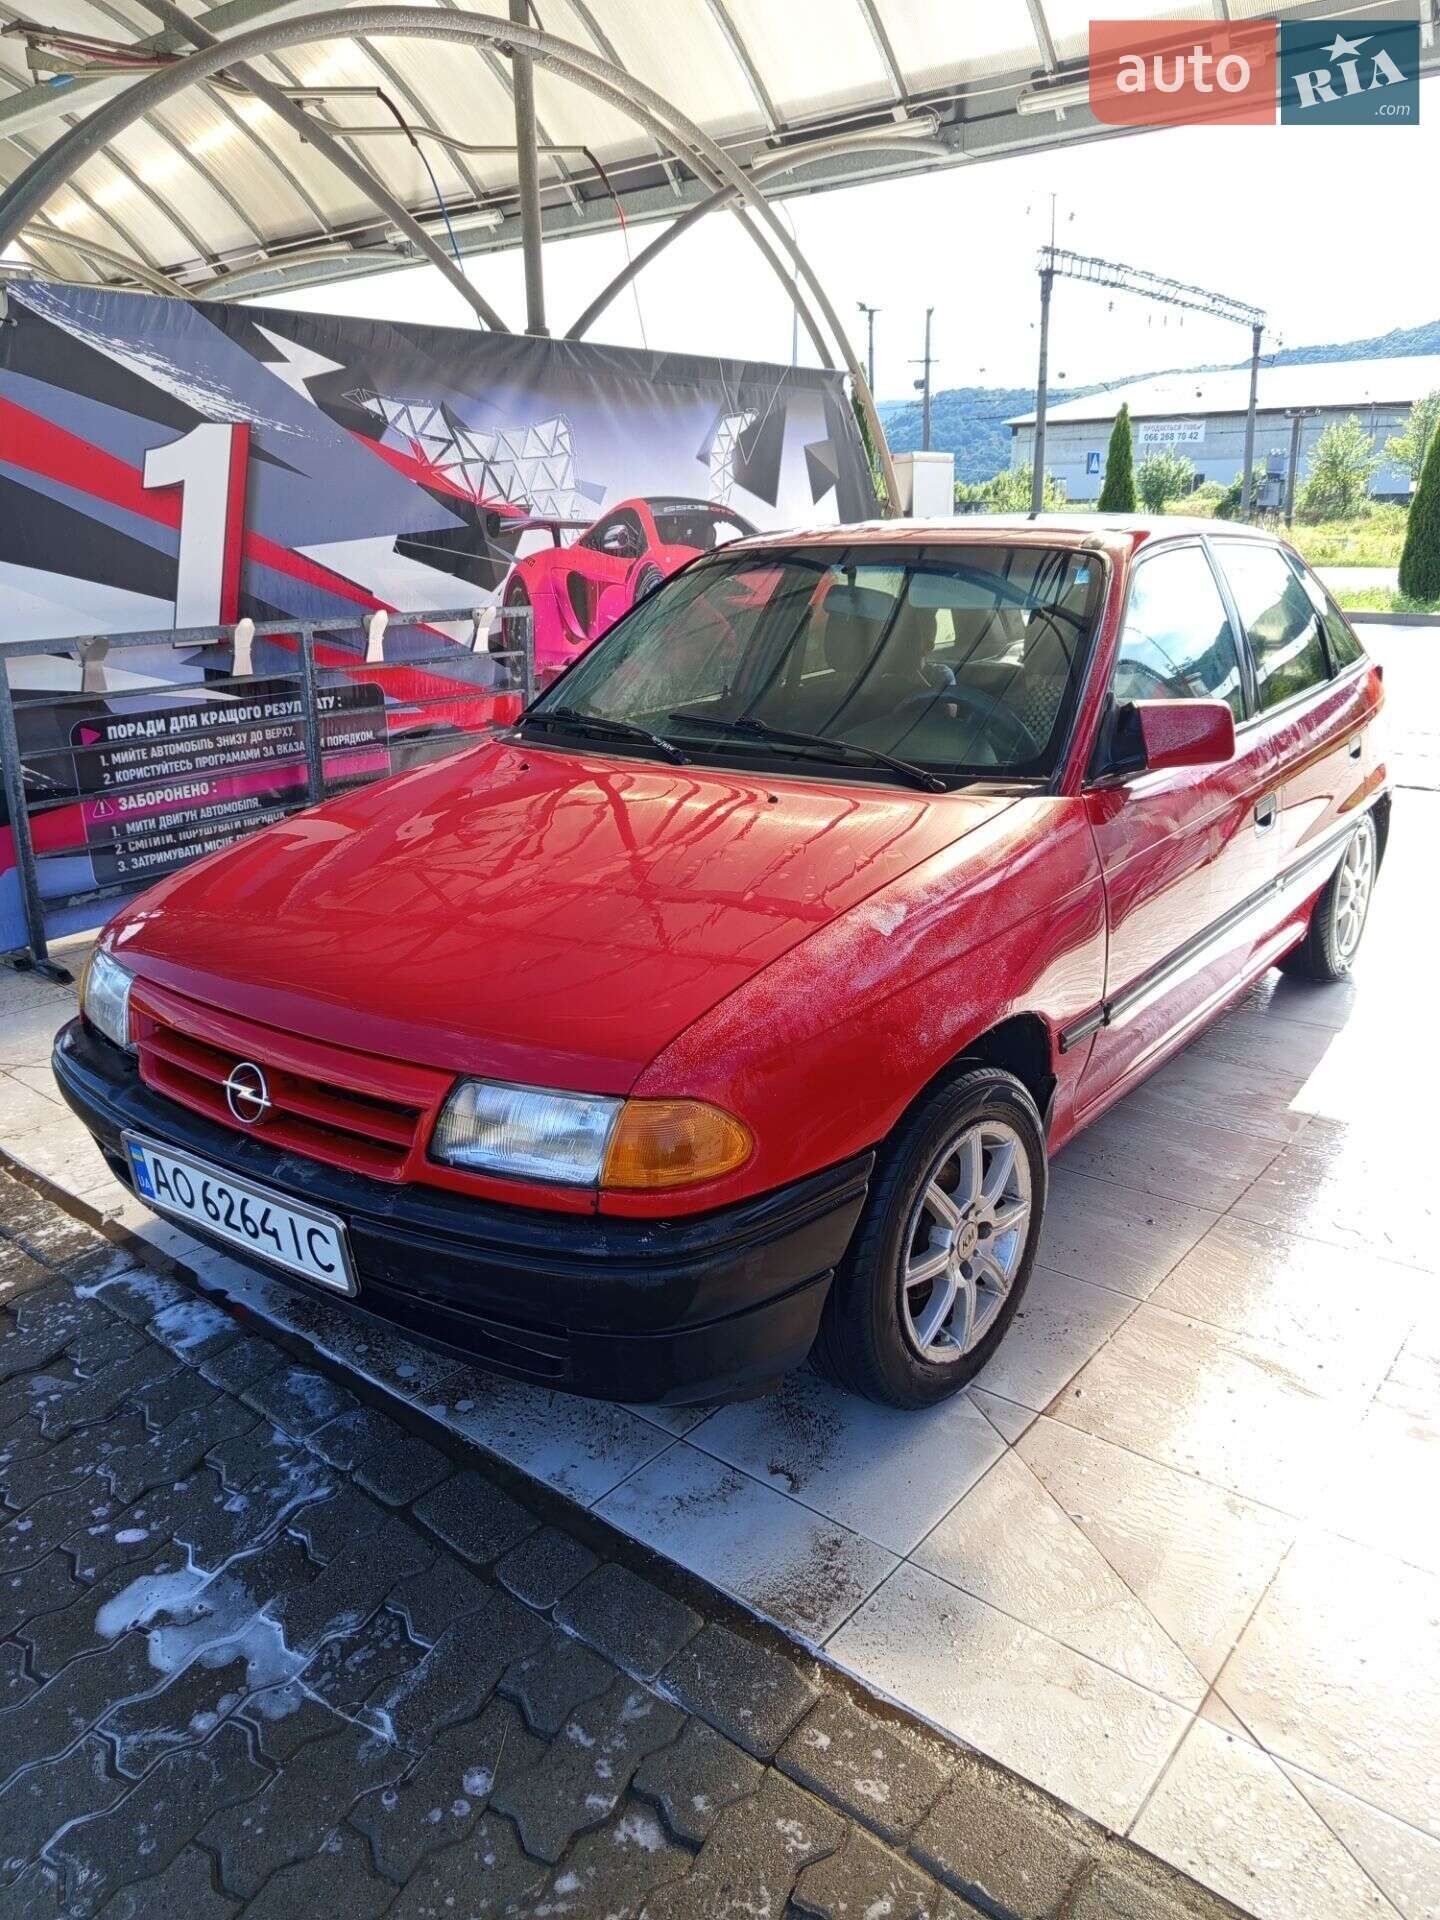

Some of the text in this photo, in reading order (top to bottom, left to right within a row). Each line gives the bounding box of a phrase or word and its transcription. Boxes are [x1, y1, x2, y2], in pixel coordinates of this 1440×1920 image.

[142, 422, 247, 648] 1
[107, 718, 166, 740] ПОРАДИ
[169, 714, 198, 734] ДЛЯ
[200, 706, 261, 726] КРАЩОГО
[103, 773, 114, 785] 2.
[115, 760, 193, 783] КОРИСТУЙТЕСЬ
[195, 747, 261, 769] ПРОГРАМАМИ
[263, 746, 275, 758] ЗА
[326, 731, 376, 747] ПОРЯДКОМ.
[111, 748, 148, 765] МИЙТЕ
[150, 738, 214, 759] АВТОМОБІЛЬ
[216, 734, 247, 748] ЗНИЗУ
[250, 730, 263, 744] ДО
[265, 725, 296, 740] ВЕРХУ.
[118, 782, 209, 811] ЗАБОРОНЕНО
[111, 797, 262, 837] 1. МИТИ ДВИГУН АВТОМОБІЛЯ.
[115, 843, 126, 855] 2.
[117, 860, 129, 872] 3.
[131, 845, 202, 869] ЗАТРИМУВАТИ
[152, 1157, 335, 1273] AO 6264 IC
